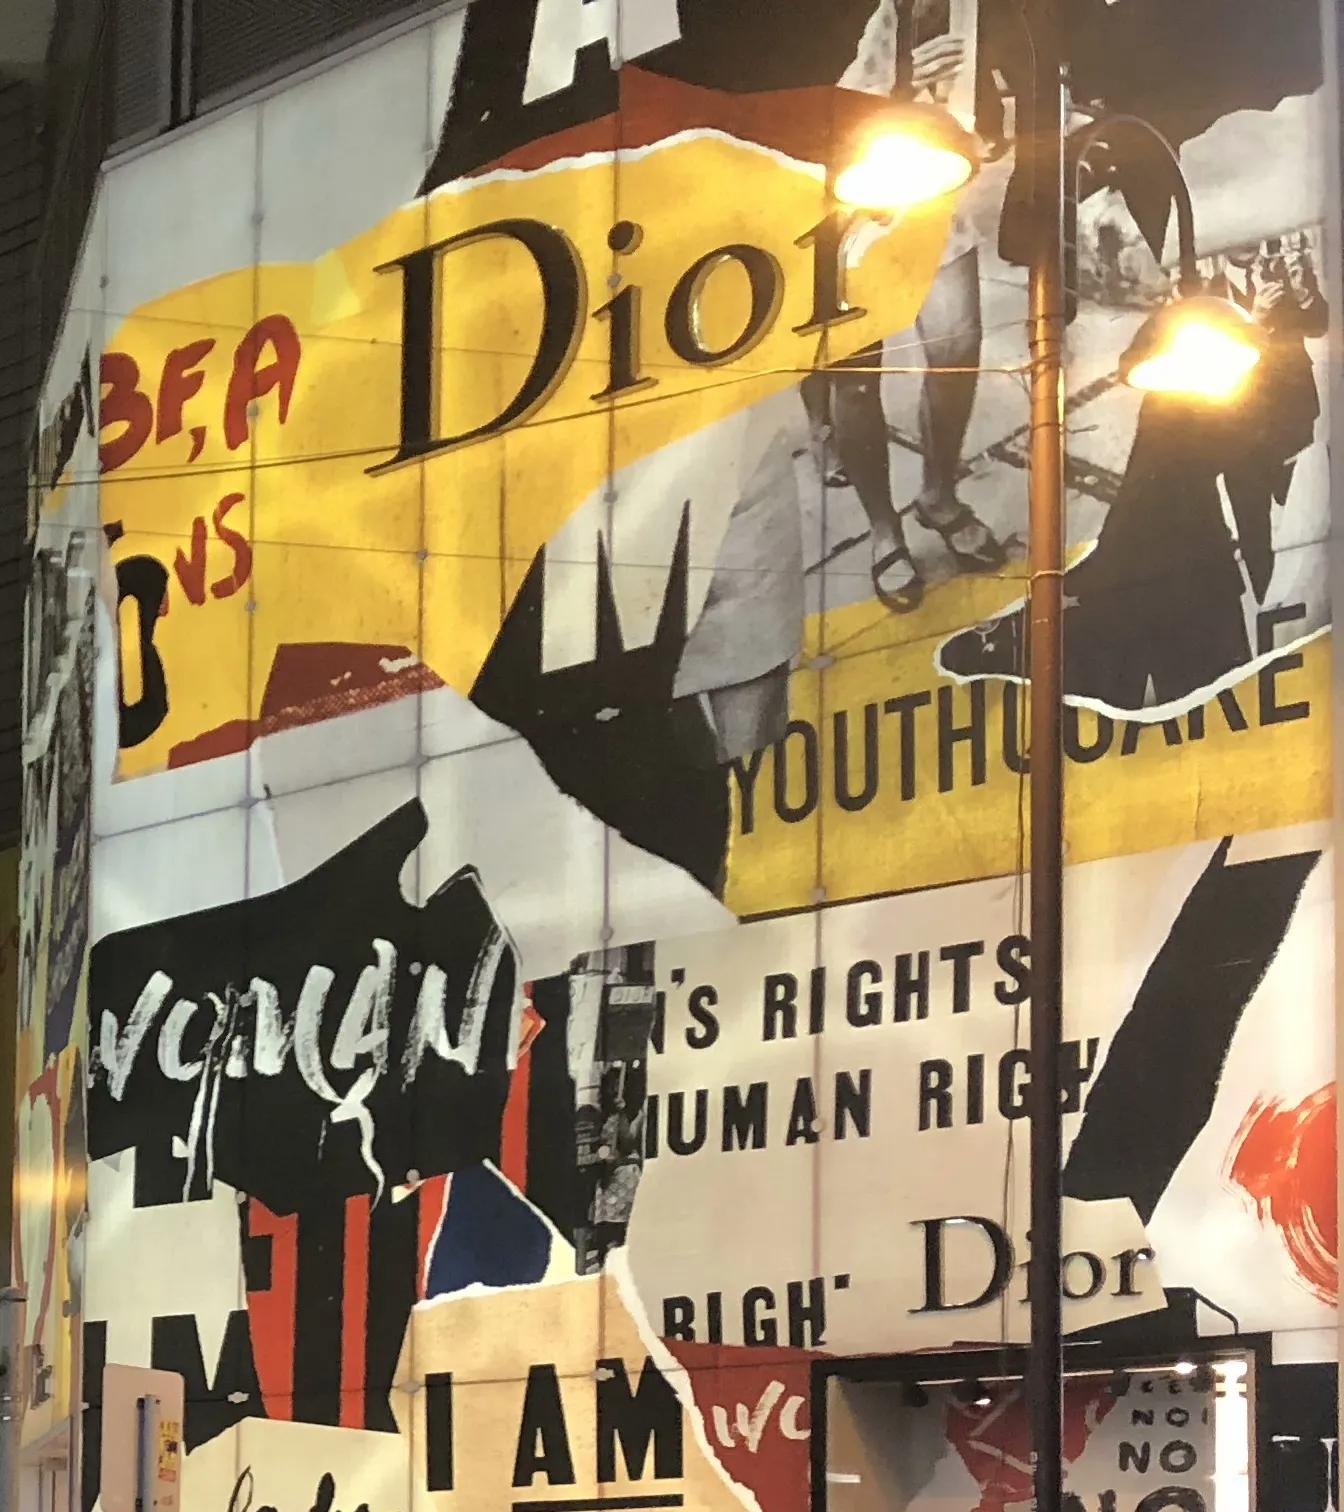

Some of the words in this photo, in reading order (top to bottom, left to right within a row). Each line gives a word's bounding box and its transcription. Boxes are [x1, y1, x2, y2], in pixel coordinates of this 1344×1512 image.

[364, 210, 868, 478] Dior
[762, 934, 1032, 1042] RIGHTS
[662, 1274, 851, 1348] RIGH
[908, 1216, 1157, 1315] Dior
[425, 1371, 453, 1493] I
[512, 1354, 684, 1489] AM
[1118, 1440, 1197, 1474] NO
